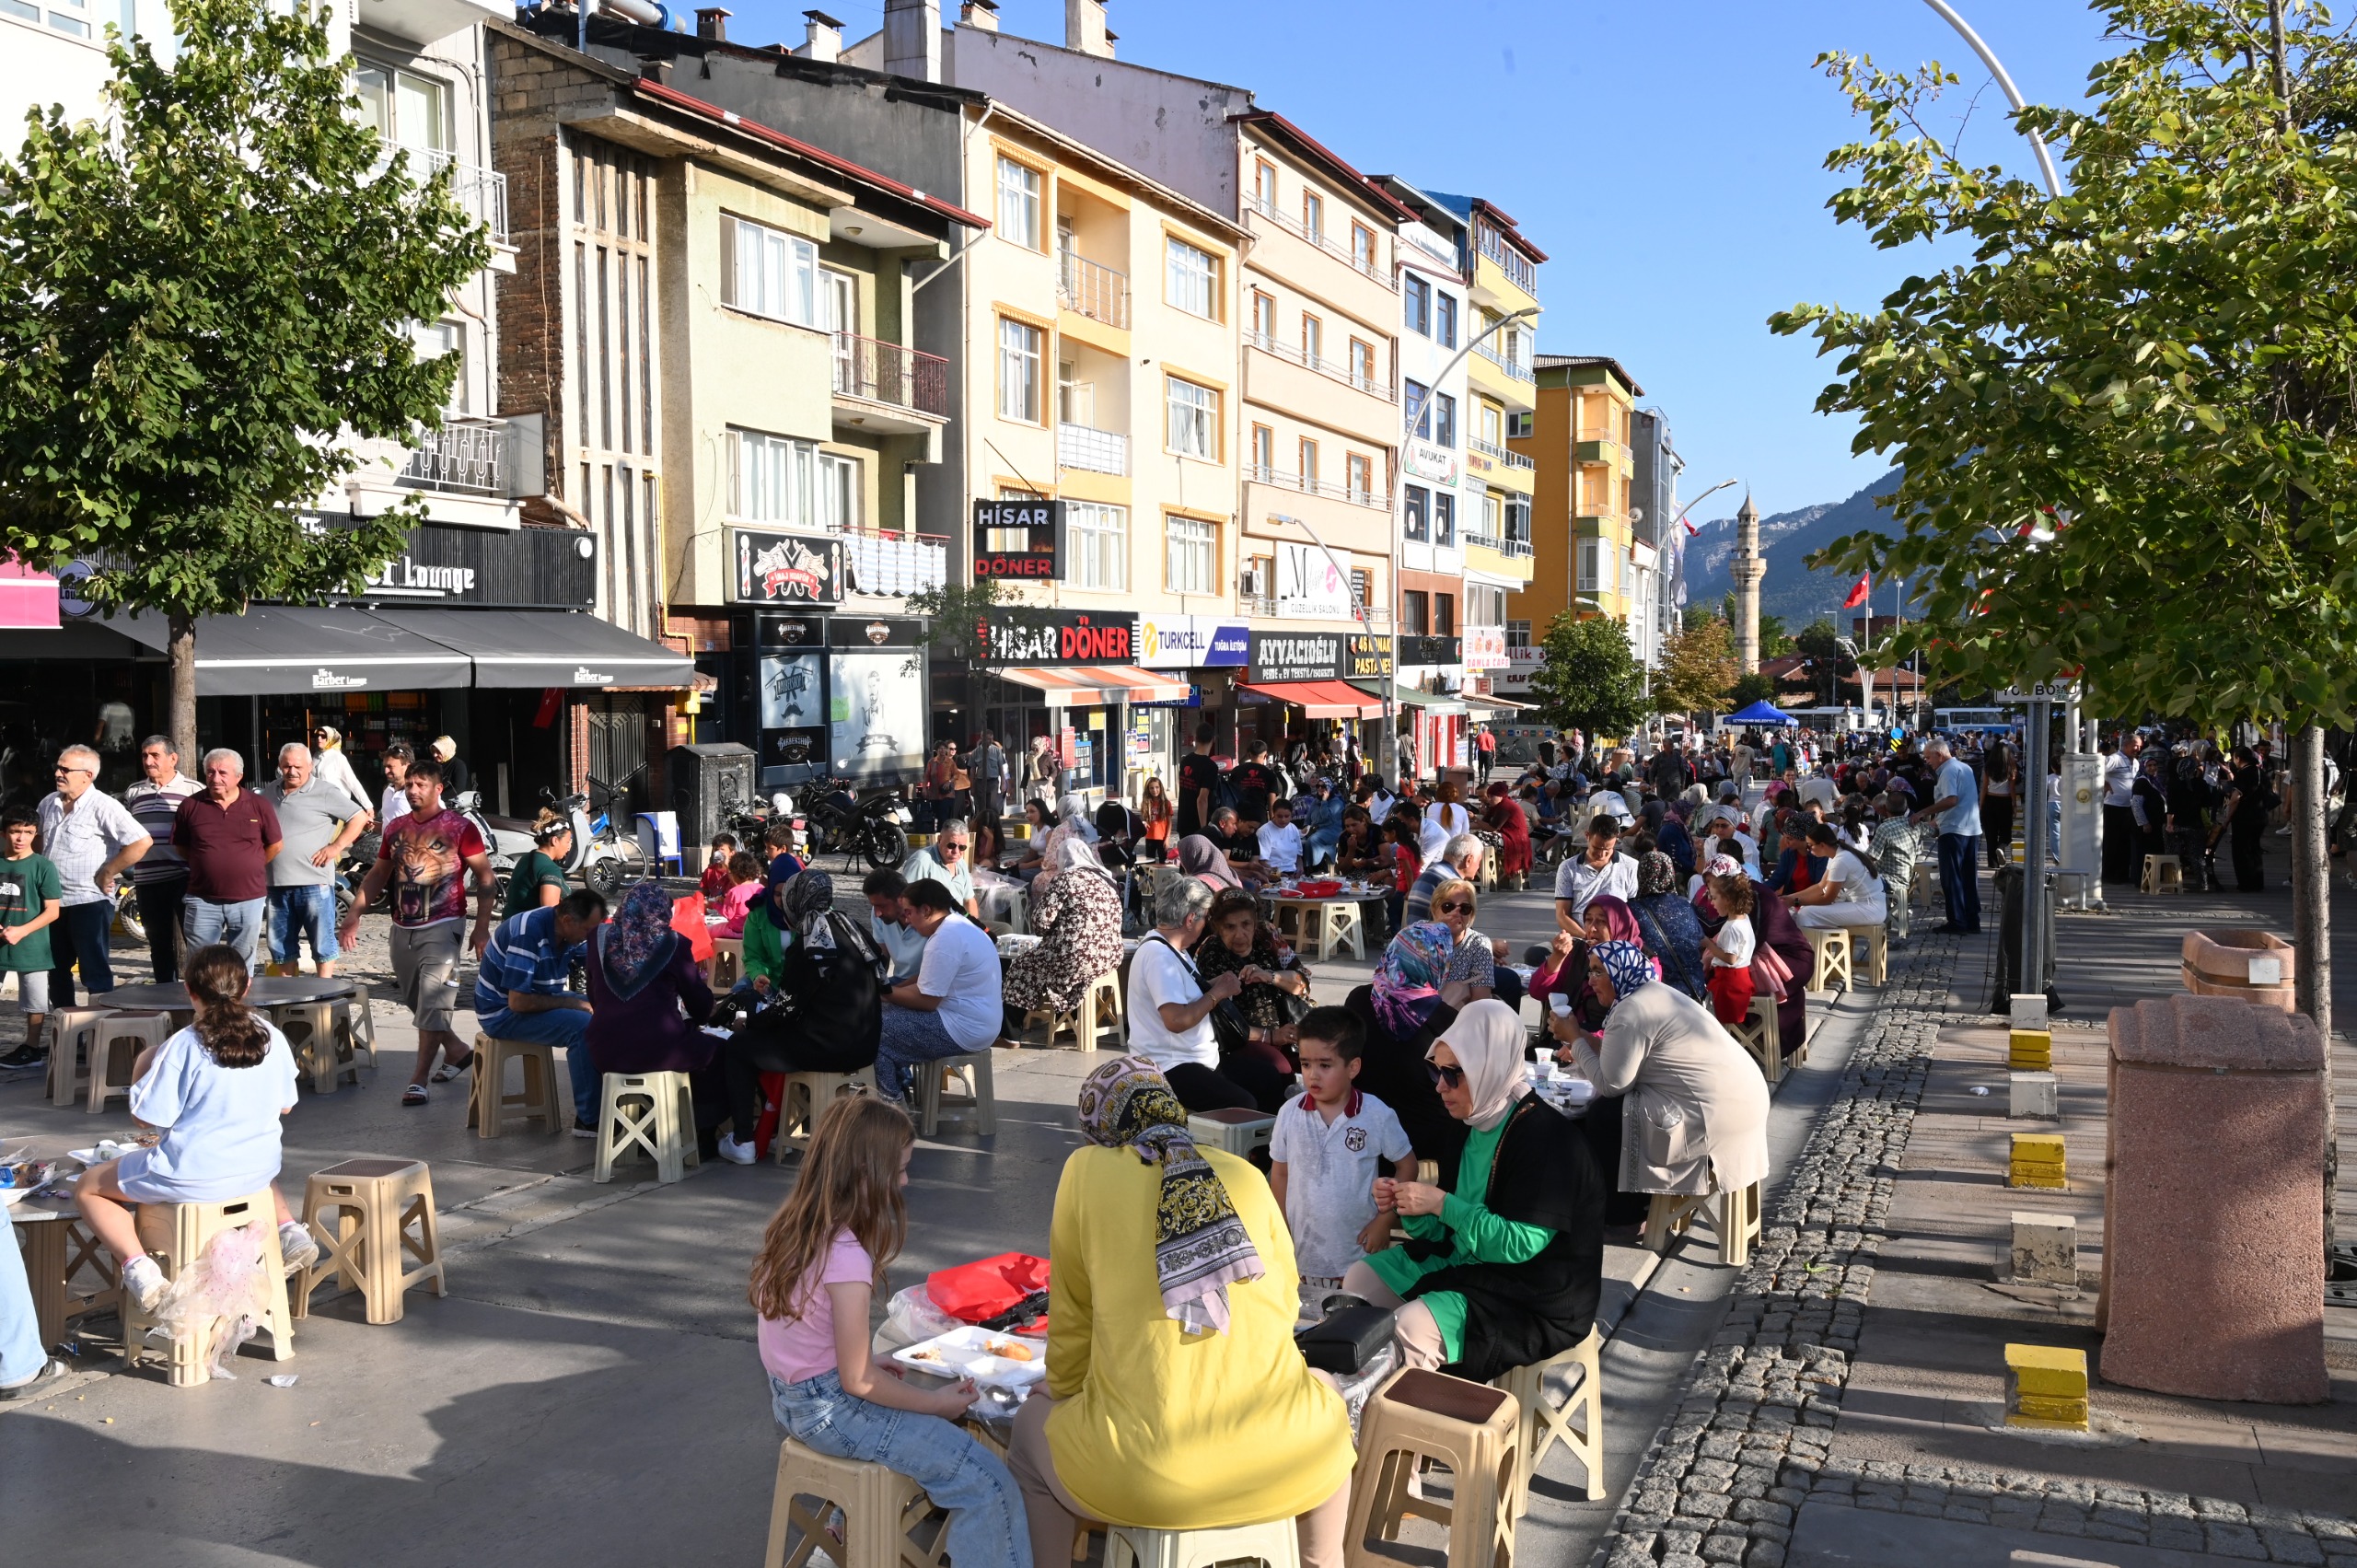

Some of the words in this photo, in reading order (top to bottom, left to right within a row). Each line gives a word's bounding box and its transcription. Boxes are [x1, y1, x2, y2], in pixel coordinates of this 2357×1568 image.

[1419, 448, 1446, 465] AVUKAT
[979, 504, 1048, 525] HİSAR
[975, 554, 1051, 575] DÖNER
[404, 556, 475, 594] Lounge
[1319, 604, 1340, 614] SALONU
[990, 616, 1058, 659] HİSAR
[1062, 616, 1130, 658] DÖNER
[1158, 631, 1205, 650] TURKCELL
[1214, 639, 1230, 652] TUĞRA
[1229, 639, 1247, 653] İLETİŞİM
[1358, 635, 1368, 652] 46
[1258, 635, 1337, 665] AYVACIOĞLU
[1467, 657, 1490, 668] DAMLA
[1492, 657, 1509, 668] CAFE
[2003, 685, 2027, 696] YO
